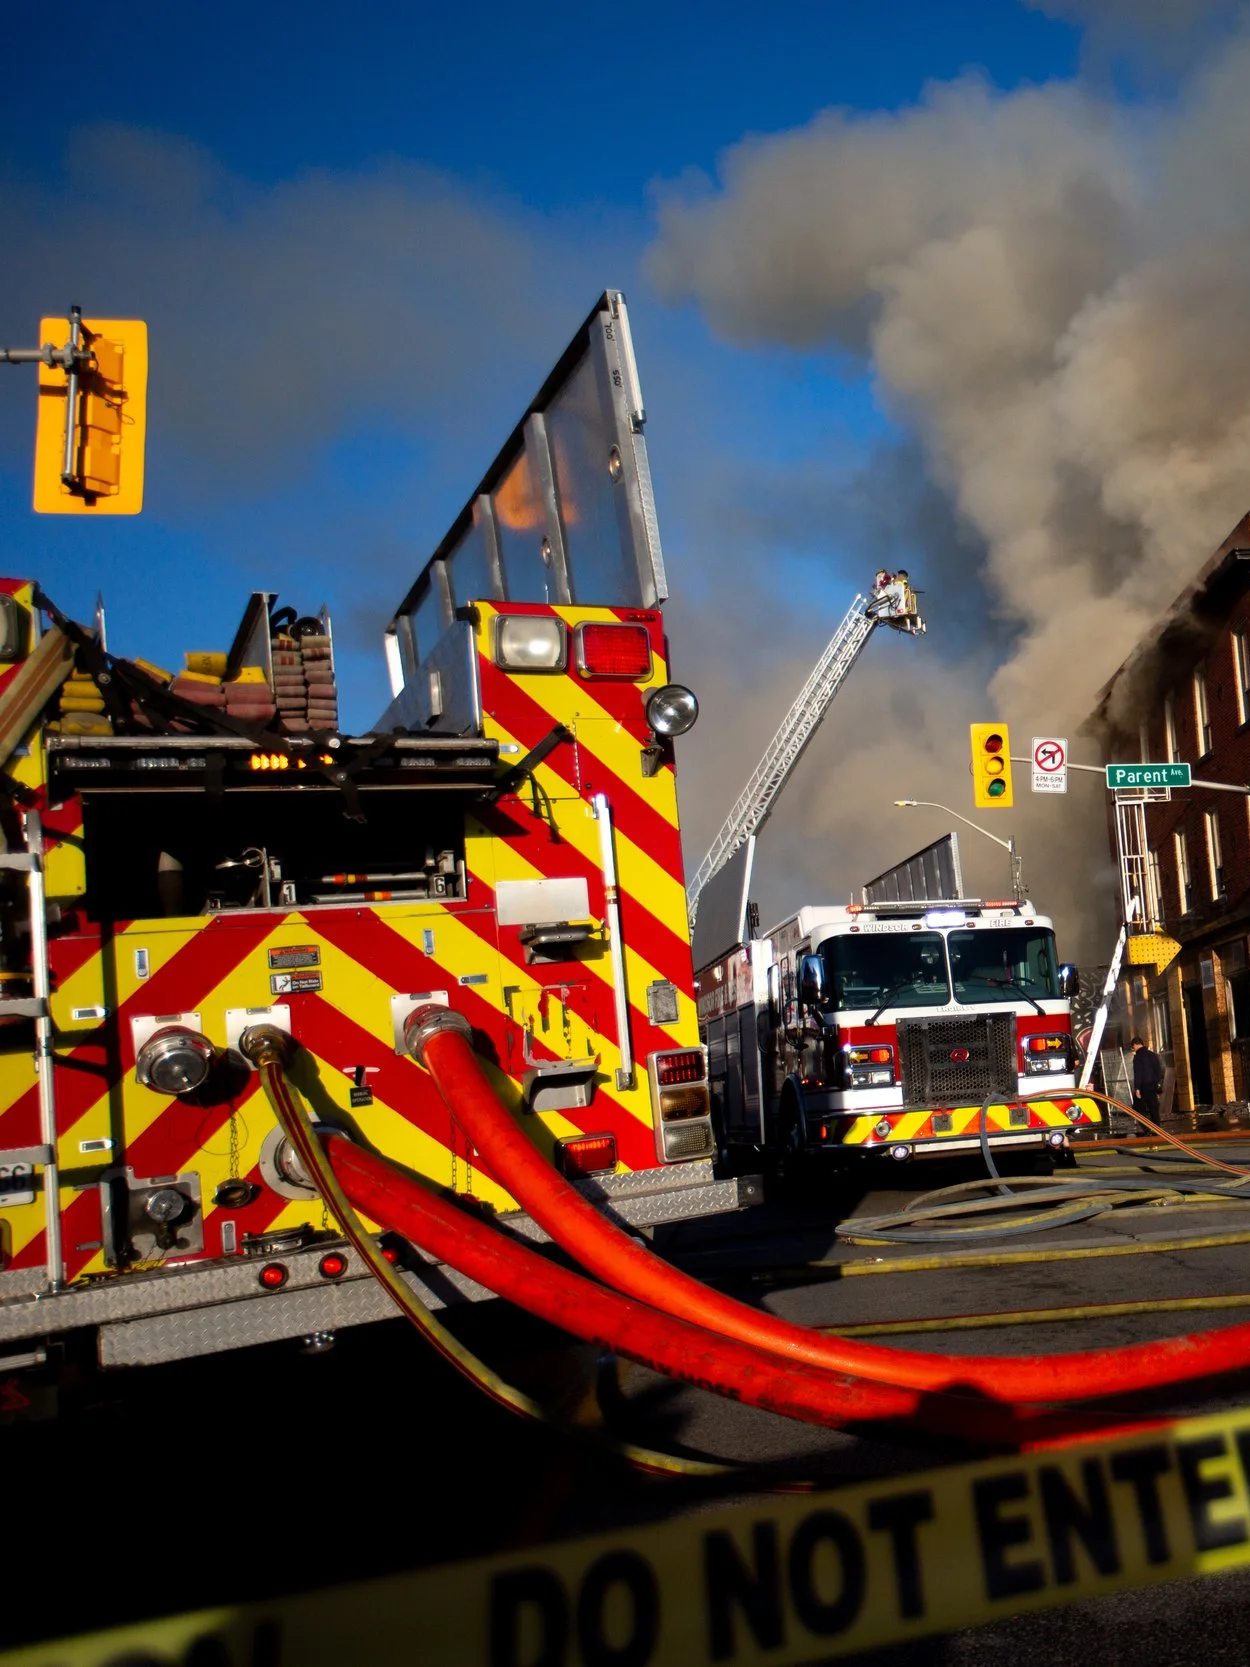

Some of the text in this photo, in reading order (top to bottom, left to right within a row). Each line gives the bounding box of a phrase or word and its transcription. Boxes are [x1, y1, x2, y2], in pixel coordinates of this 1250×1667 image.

[1117, 768, 1168, 783] Parent
[434, 876, 446, 894] 6
[863, 919, 1012, 933] WINDSOR FIRE
[492, 1548, 660, 1667] DO
[705, 1492, 934, 1660] NOT
